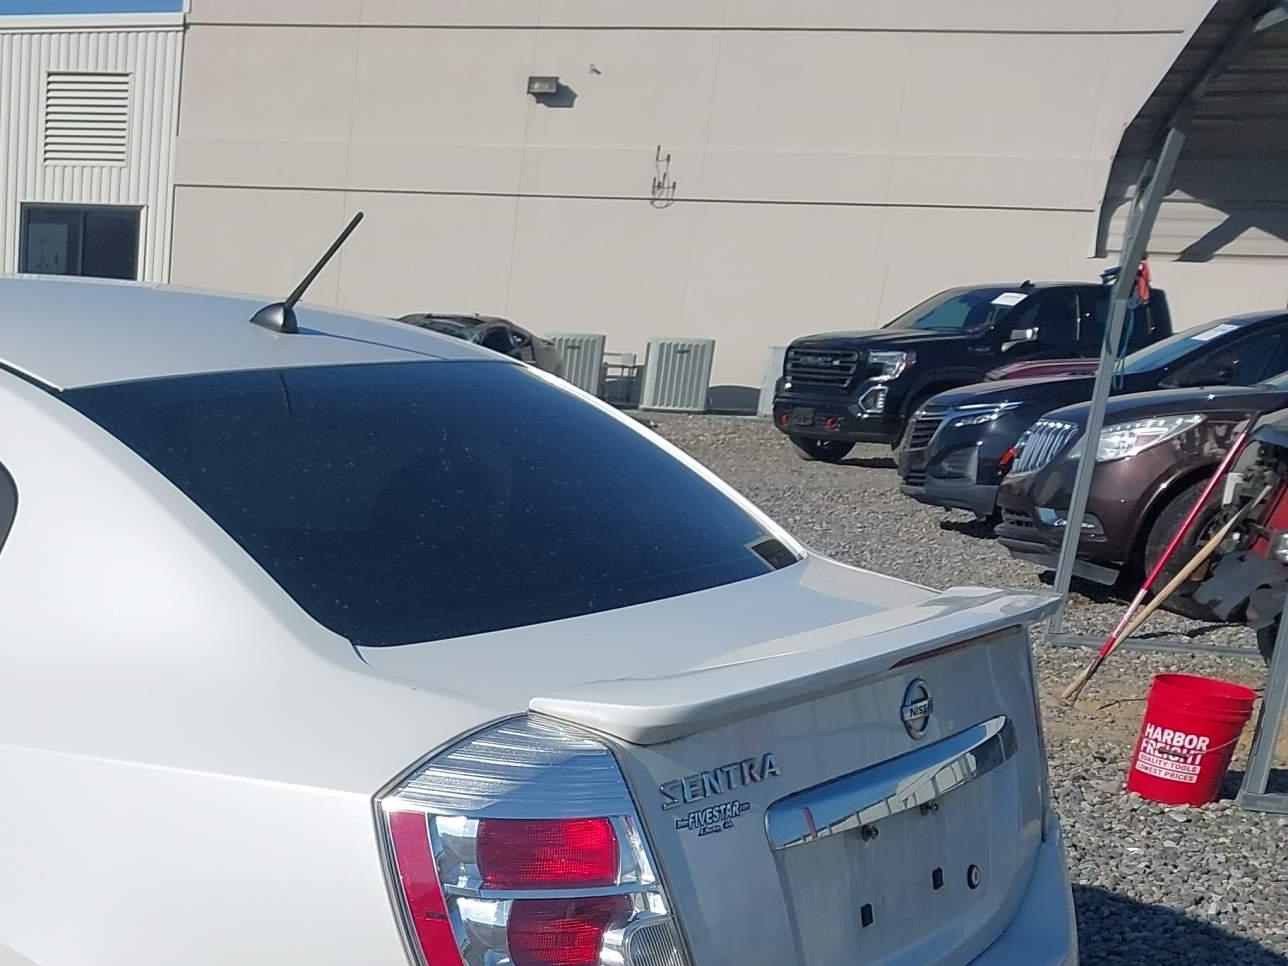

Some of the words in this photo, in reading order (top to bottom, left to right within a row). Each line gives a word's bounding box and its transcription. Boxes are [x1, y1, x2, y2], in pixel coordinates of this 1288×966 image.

[1144, 722, 1210, 751] HARBOR
[1137, 762, 1163, 775] LOWEST
[1164, 771, 1195, 782] PRICES
[1140, 753, 1169, 767] QUALITY
[1169, 762, 1198, 773] TOOLS
[659, 752, 782, 811] SENTRA
[687, 800, 741, 831] FIVESTAR
